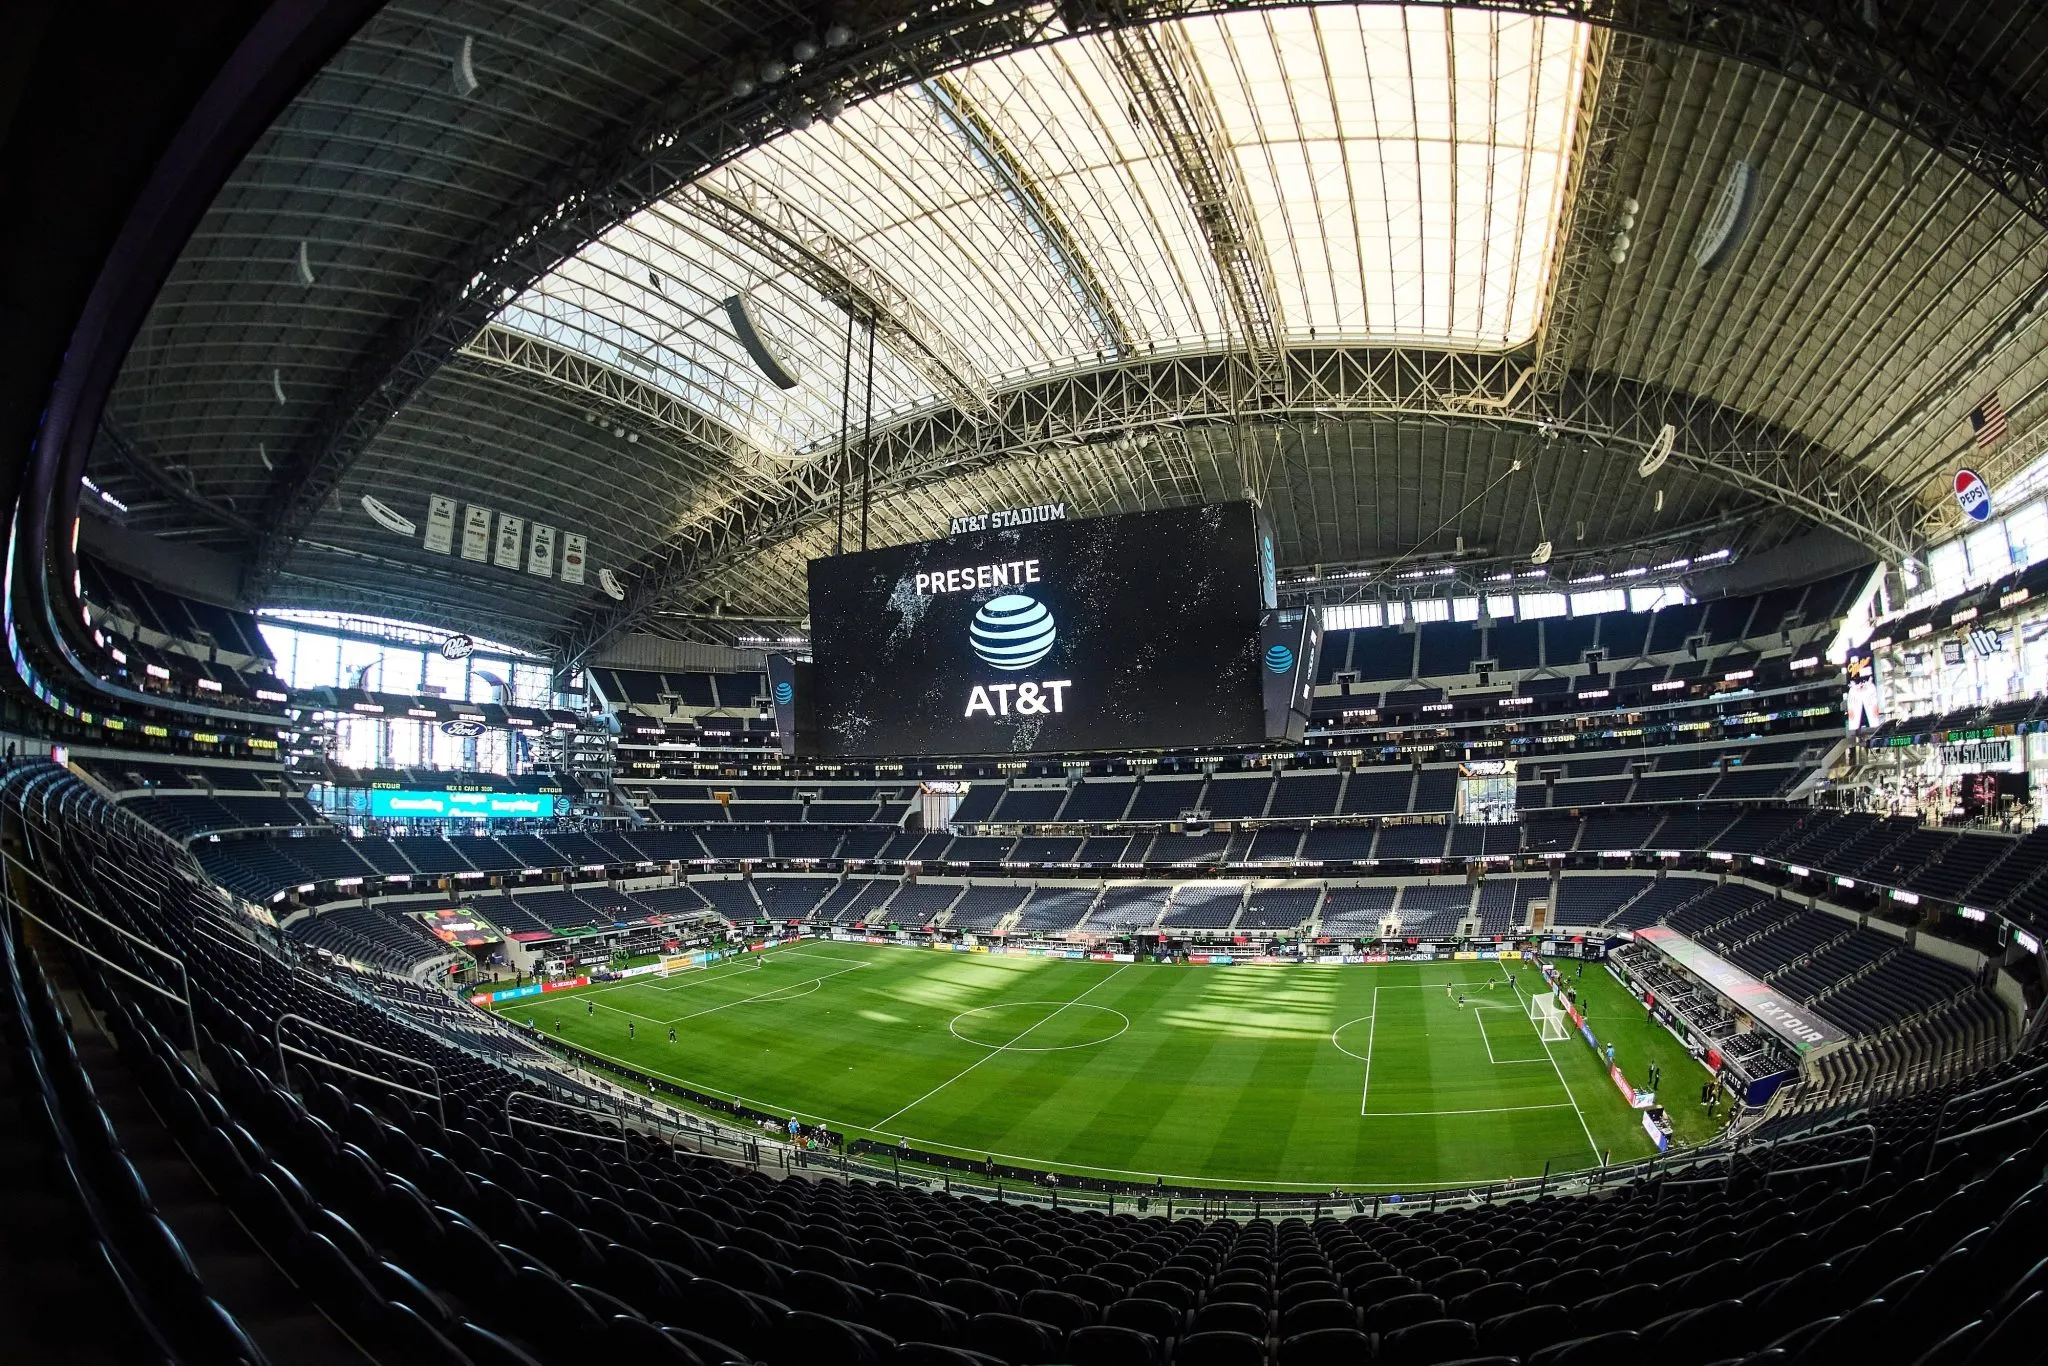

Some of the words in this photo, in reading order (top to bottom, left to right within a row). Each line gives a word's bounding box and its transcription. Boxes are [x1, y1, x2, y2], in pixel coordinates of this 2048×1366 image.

[1960, 486, 1985, 506] PEPSI
[950, 513, 988, 535] AT&T
[992, 503, 1066, 529] STADIUM
[915, 560, 1041, 596] PRESENTE
[445, 639, 471, 657] Pepper
[457, 638, 468, 646] Dr
[964, 680, 1072, 717] AT&T
[448, 723, 480, 735] Ford
[1613, 729, 1642, 737] EXTOUR
[1940, 744, 1961, 765] AT&T
[1963, 741, 2009, 763] STADIUM
